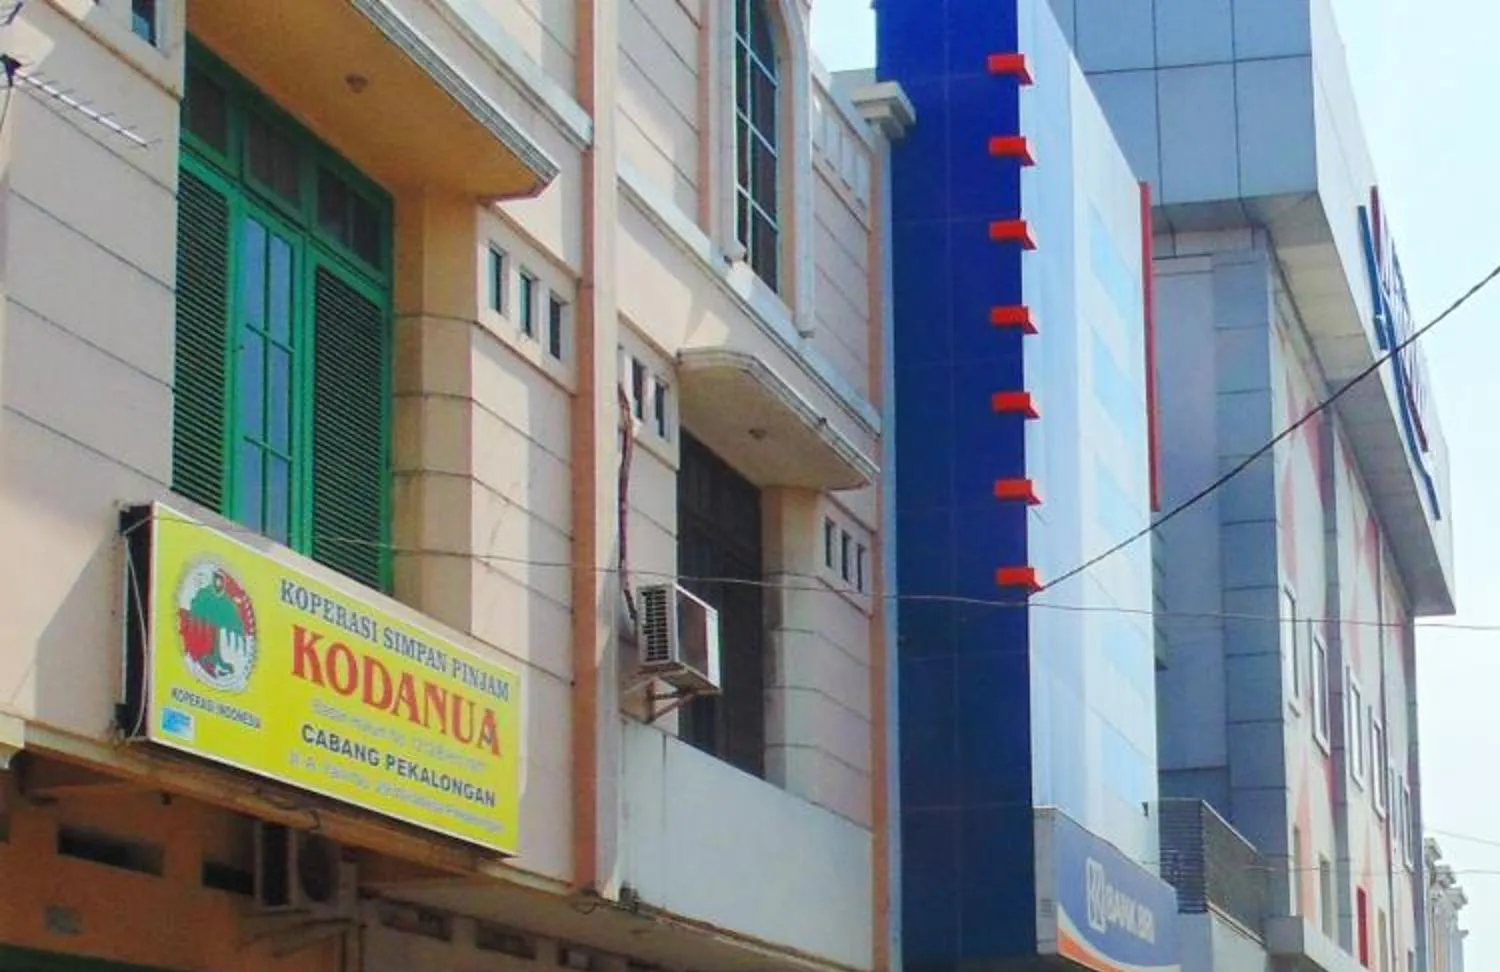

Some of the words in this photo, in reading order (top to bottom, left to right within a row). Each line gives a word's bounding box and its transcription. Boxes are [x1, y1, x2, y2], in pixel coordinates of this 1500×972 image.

[281, 578, 378, 643] KOPERASI
[383, 625, 447, 675] SIMPAN
[451, 660, 510, 703] PINJAM
[291, 624, 502, 757] KODANUA
[301, 723, 381, 767] CABANG
[385, 753, 496, 809] PEKALONGAN
